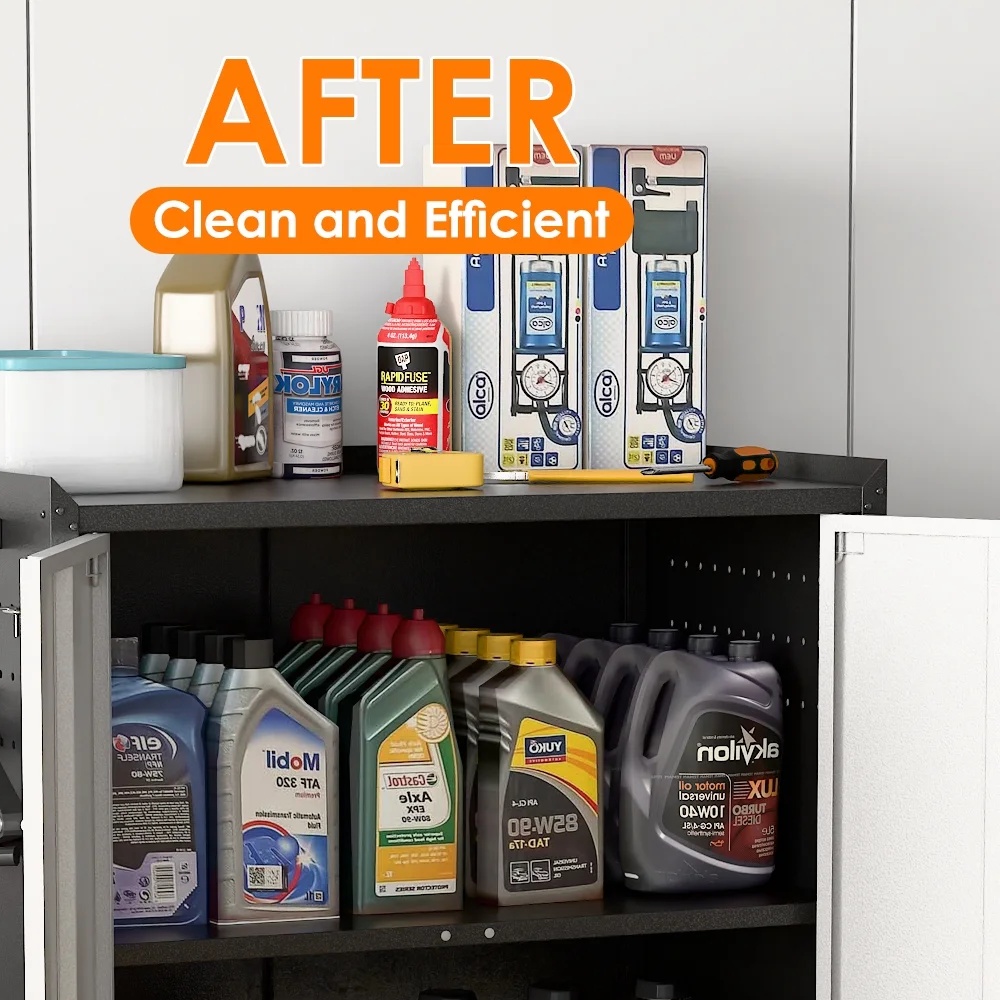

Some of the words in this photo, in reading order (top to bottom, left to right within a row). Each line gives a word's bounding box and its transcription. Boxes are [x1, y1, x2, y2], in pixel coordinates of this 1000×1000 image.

[381, 385, 396, 393] WOOD
[397, 386, 428, 394] ADHESIVE
[472, 376, 486, 416] alca
[599, 374, 612, 414] alca
